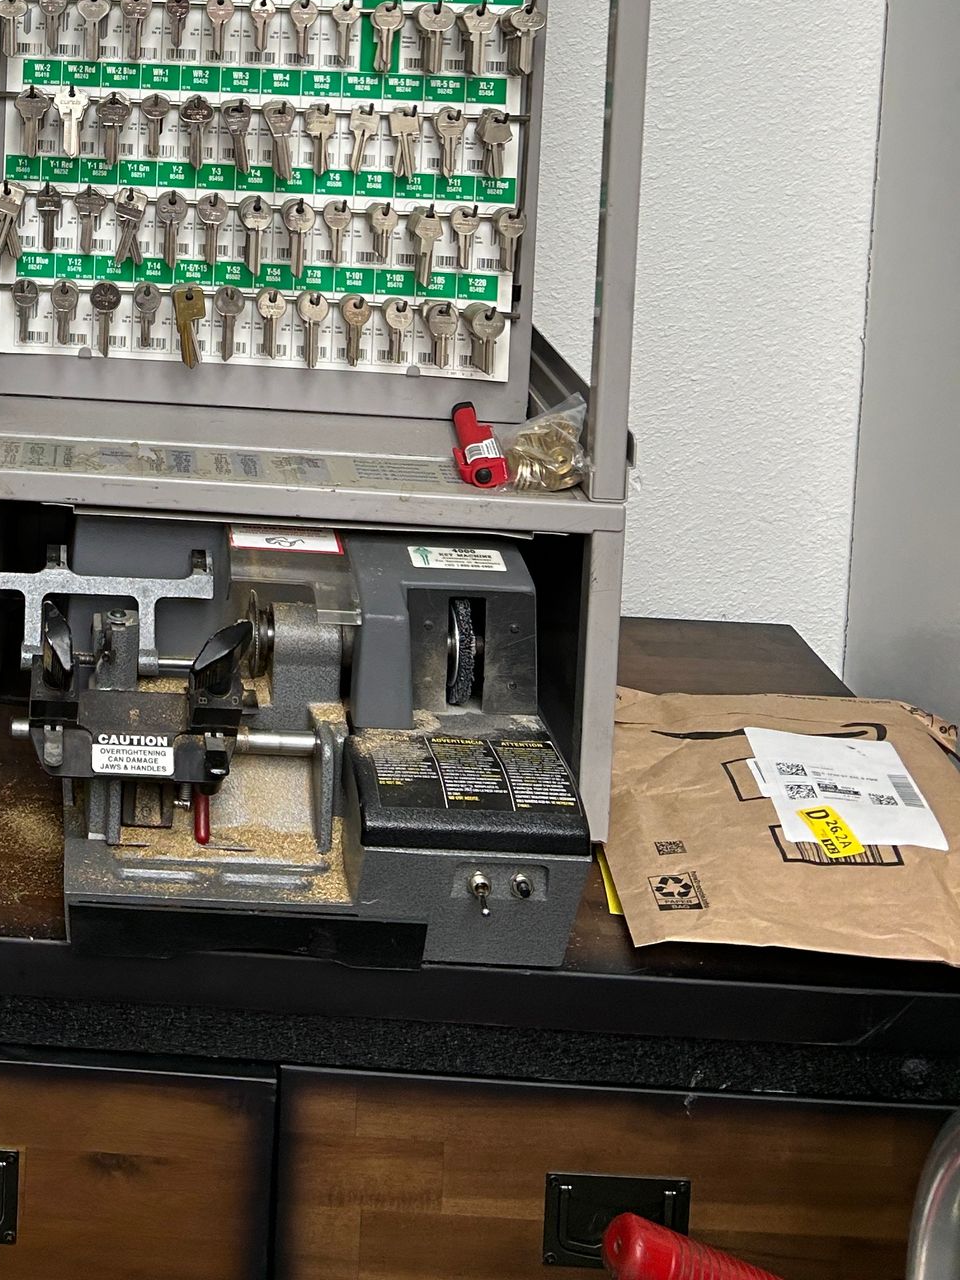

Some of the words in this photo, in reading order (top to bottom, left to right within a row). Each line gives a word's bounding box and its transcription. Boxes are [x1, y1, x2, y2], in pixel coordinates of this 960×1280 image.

[35, 64, 50, 72] WK-2
[273, 73, 290, 81] WR-4
[128, 164, 137, 172] Y-1
[139, 164, 149, 172] Grn
[251, 169, 260, 177] Y-4
[22, 256, 34, 264] Y-11
[68, 258, 81, 266] Y-12
[98, 733, 168, 746] CAUTION
[431, 738, 484, 746] ADVERTENCIA
[500, 740, 544, 748] ATTENTION
[100, 748, 167, 756] OVERTIGHTENING
[126, 756, 159, 764] DAMAGE
[131, 764, 167, 772] HANDLES
[804, 808, 830, 820] D
